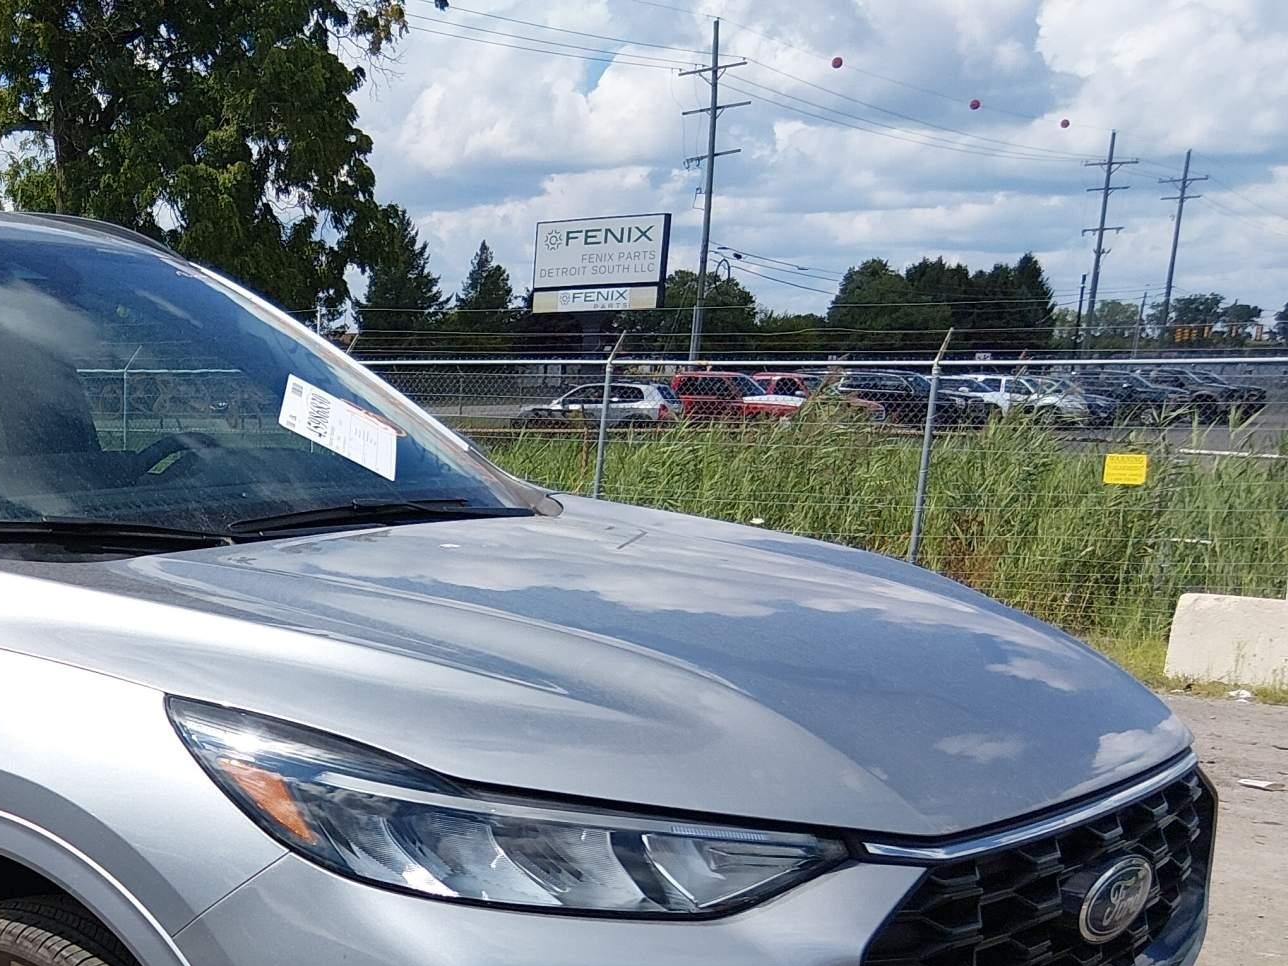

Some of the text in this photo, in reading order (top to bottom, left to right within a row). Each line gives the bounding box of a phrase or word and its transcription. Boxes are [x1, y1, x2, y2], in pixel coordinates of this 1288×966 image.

[565, 225, 656, 246] FENIX
[581, 250, 656, 264] FENIX PARTS
[539, 262, 655, 278] DETROIT SOUTH LLC
[572, 289, 628, 303] FENIX
